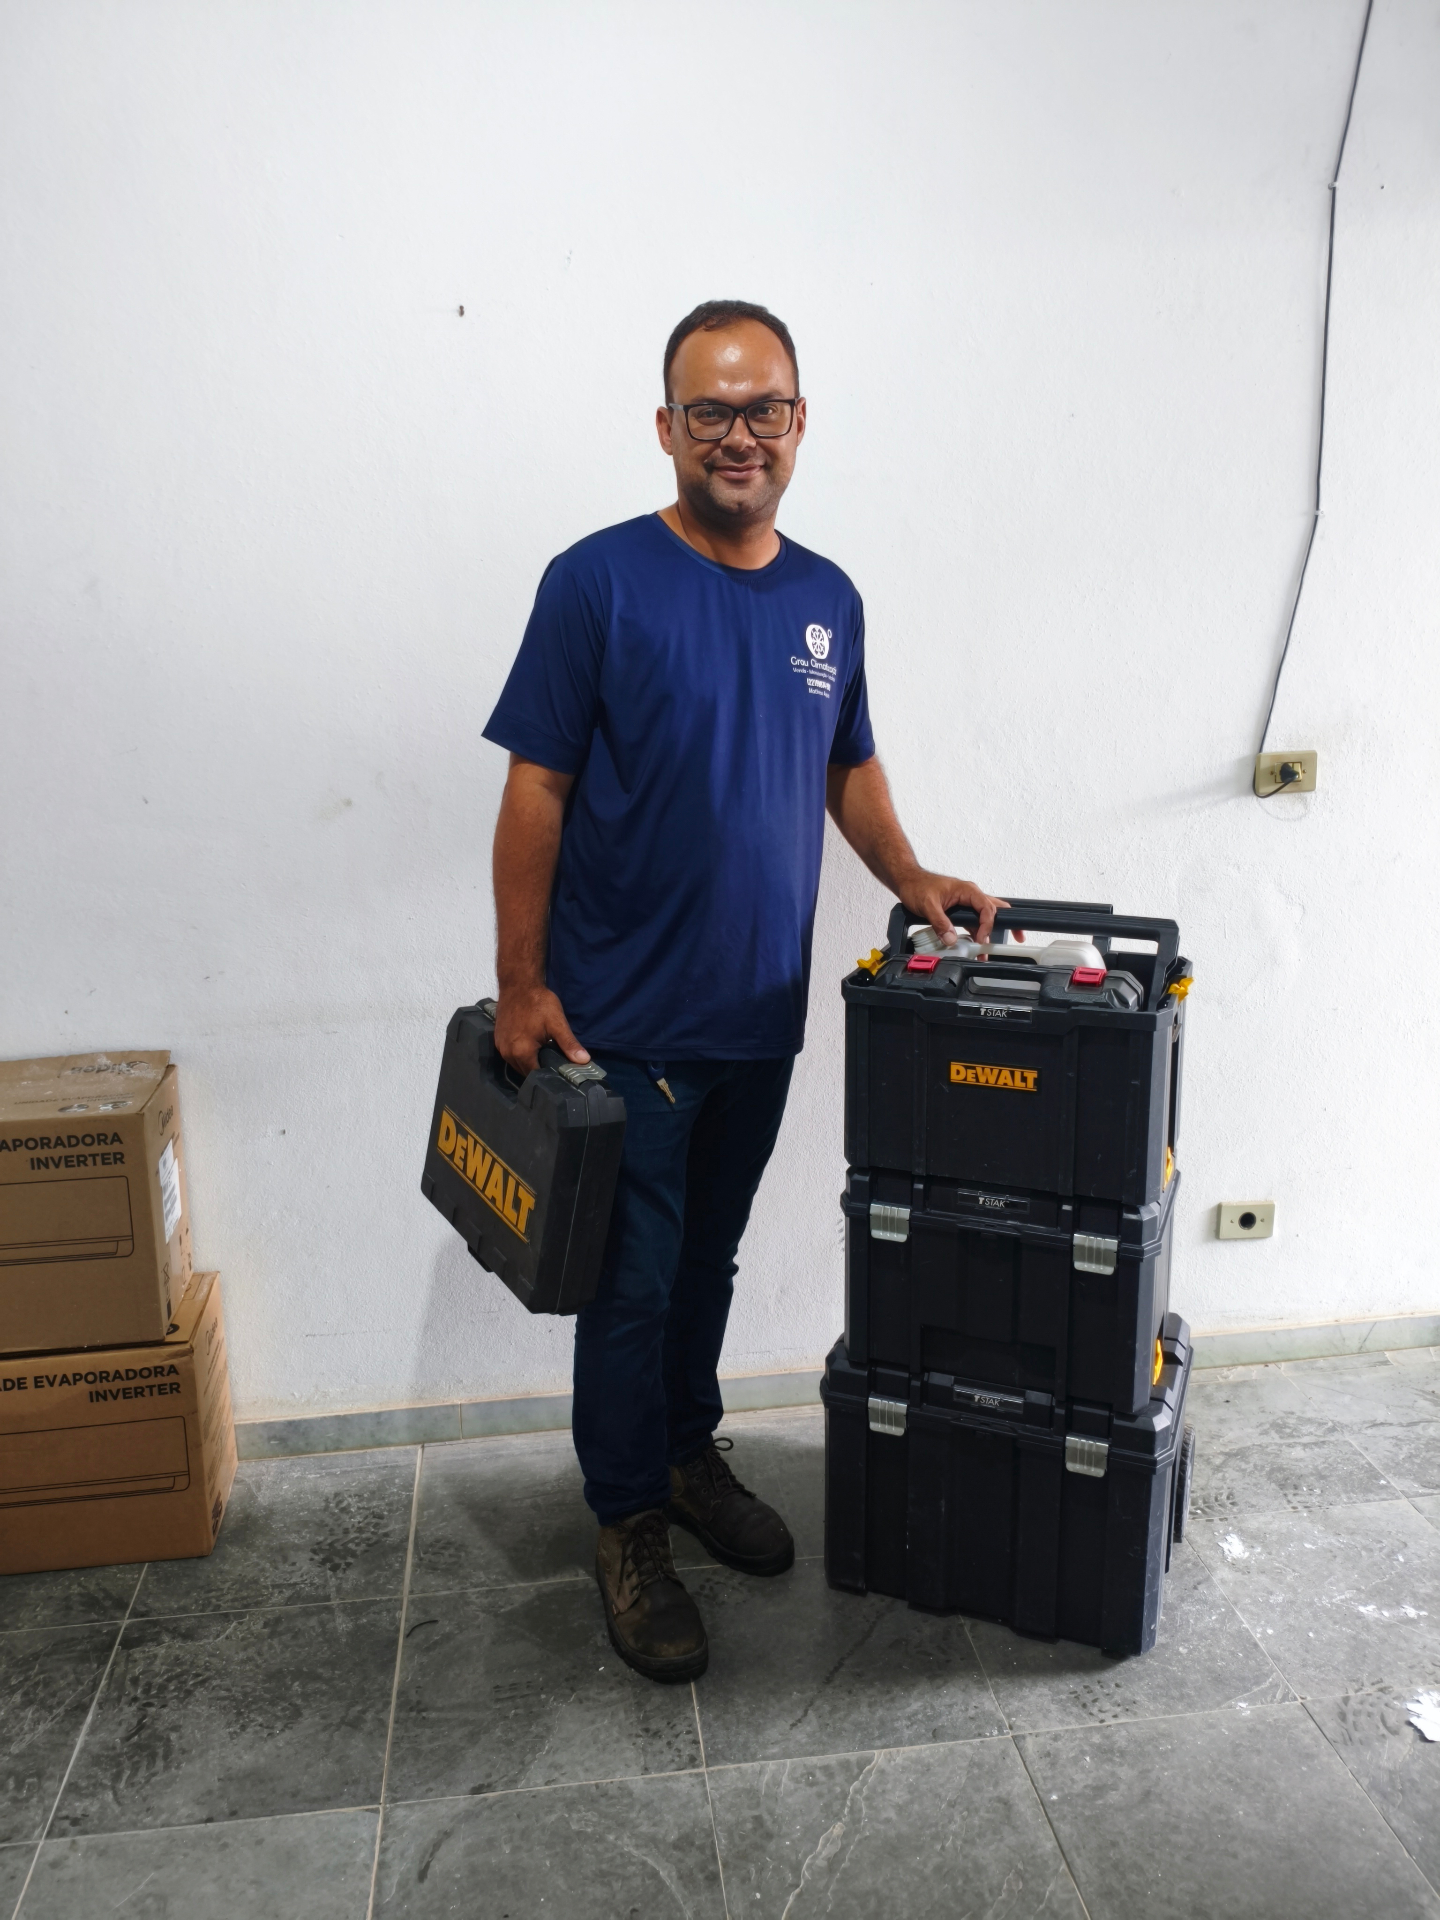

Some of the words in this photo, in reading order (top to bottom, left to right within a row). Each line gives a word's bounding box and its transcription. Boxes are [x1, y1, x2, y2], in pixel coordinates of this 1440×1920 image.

[790, 656, 809, 667] Grau
[950, 1064, 1038, 1089] DEWALT
[0, 1131, 124, 1153] APORADORA
[30, 1151, 126, 1171] INVERTER
[436, 1109, 536, 1235] DEWALT
[0, 1376, 28, 1392] DE
[33, 1364, 180, 1389] EVAPORADORA
[88, 1381, 182, 1403] INVERTER
